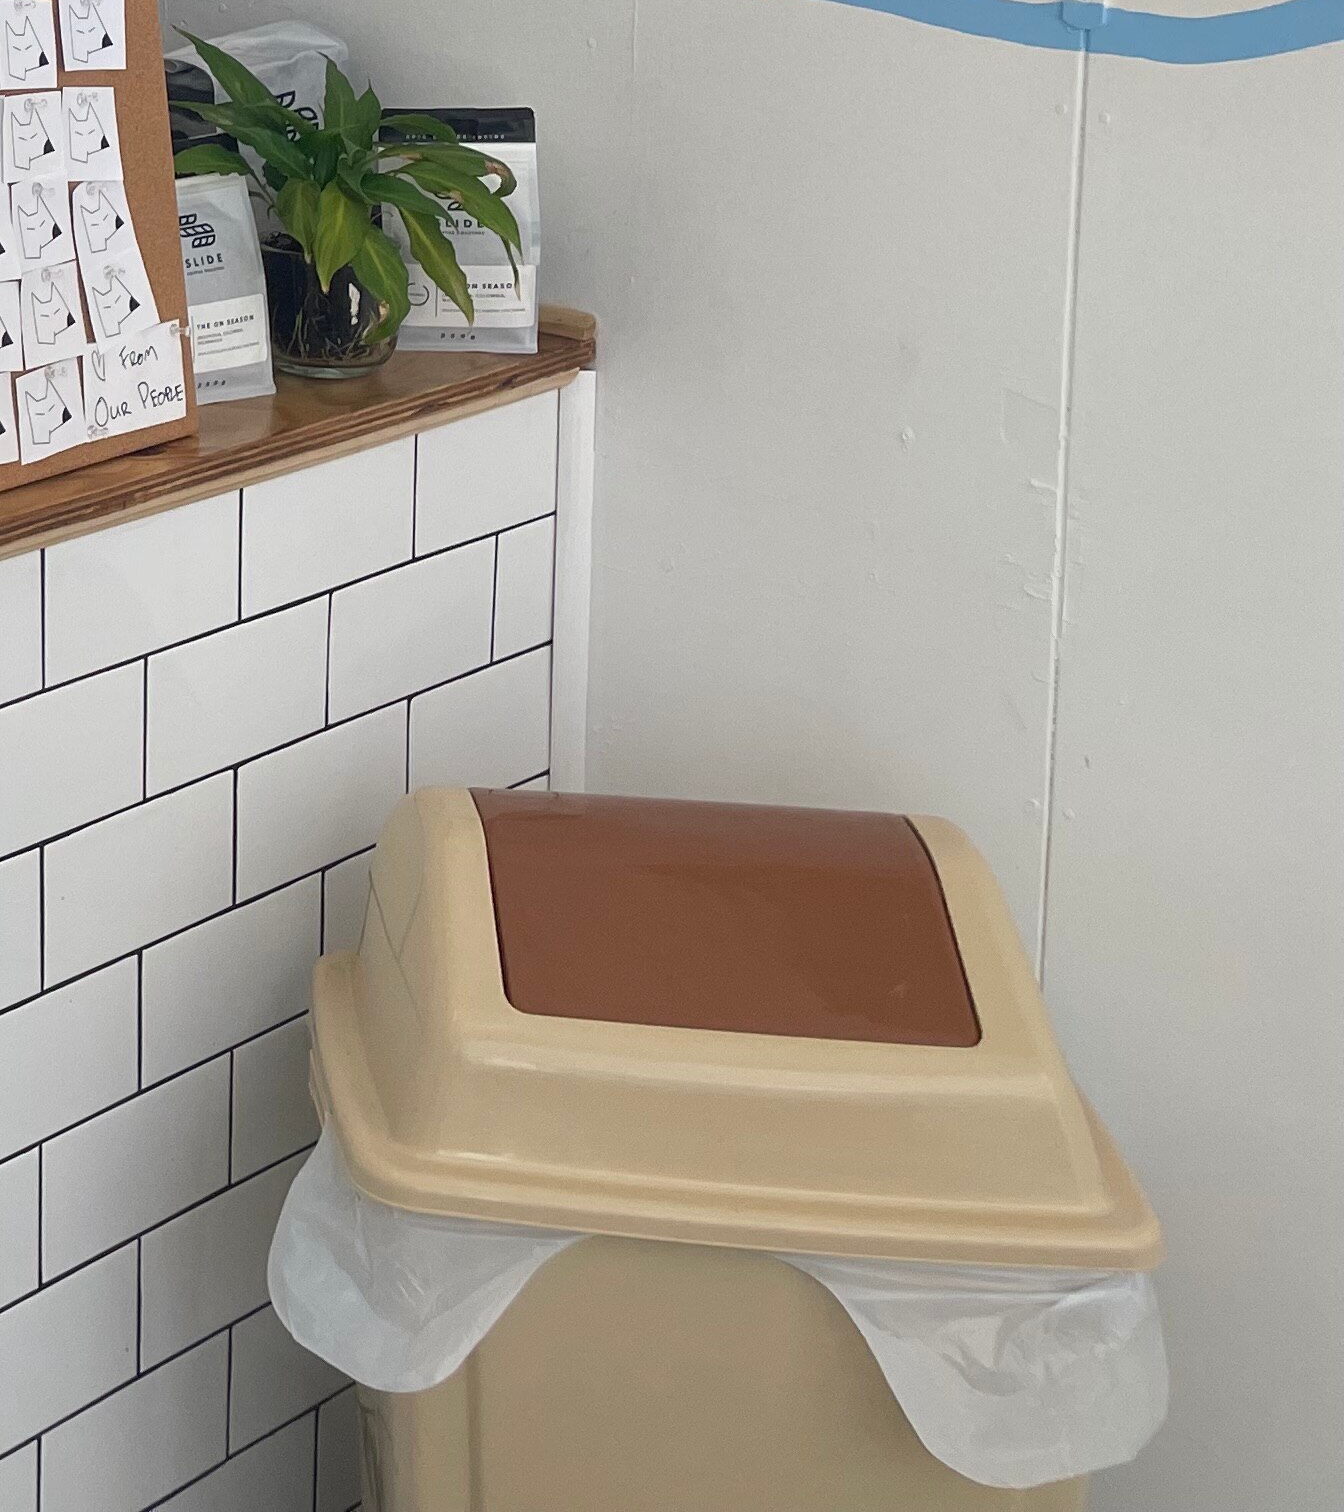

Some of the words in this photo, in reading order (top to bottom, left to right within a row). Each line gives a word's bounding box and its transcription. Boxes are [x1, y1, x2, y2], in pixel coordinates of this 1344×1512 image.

[185, 252, 224, 270] SLIDE
[482, 282, 513, 290] SEASO
[213, 320, 225, 328] ON
[227, 314, 256, 326] SEASON
[118, 346, 159, 371] FROM
[93, 397, 132, 428] OUR
[138, 384, 186, 413] PEOPLE
